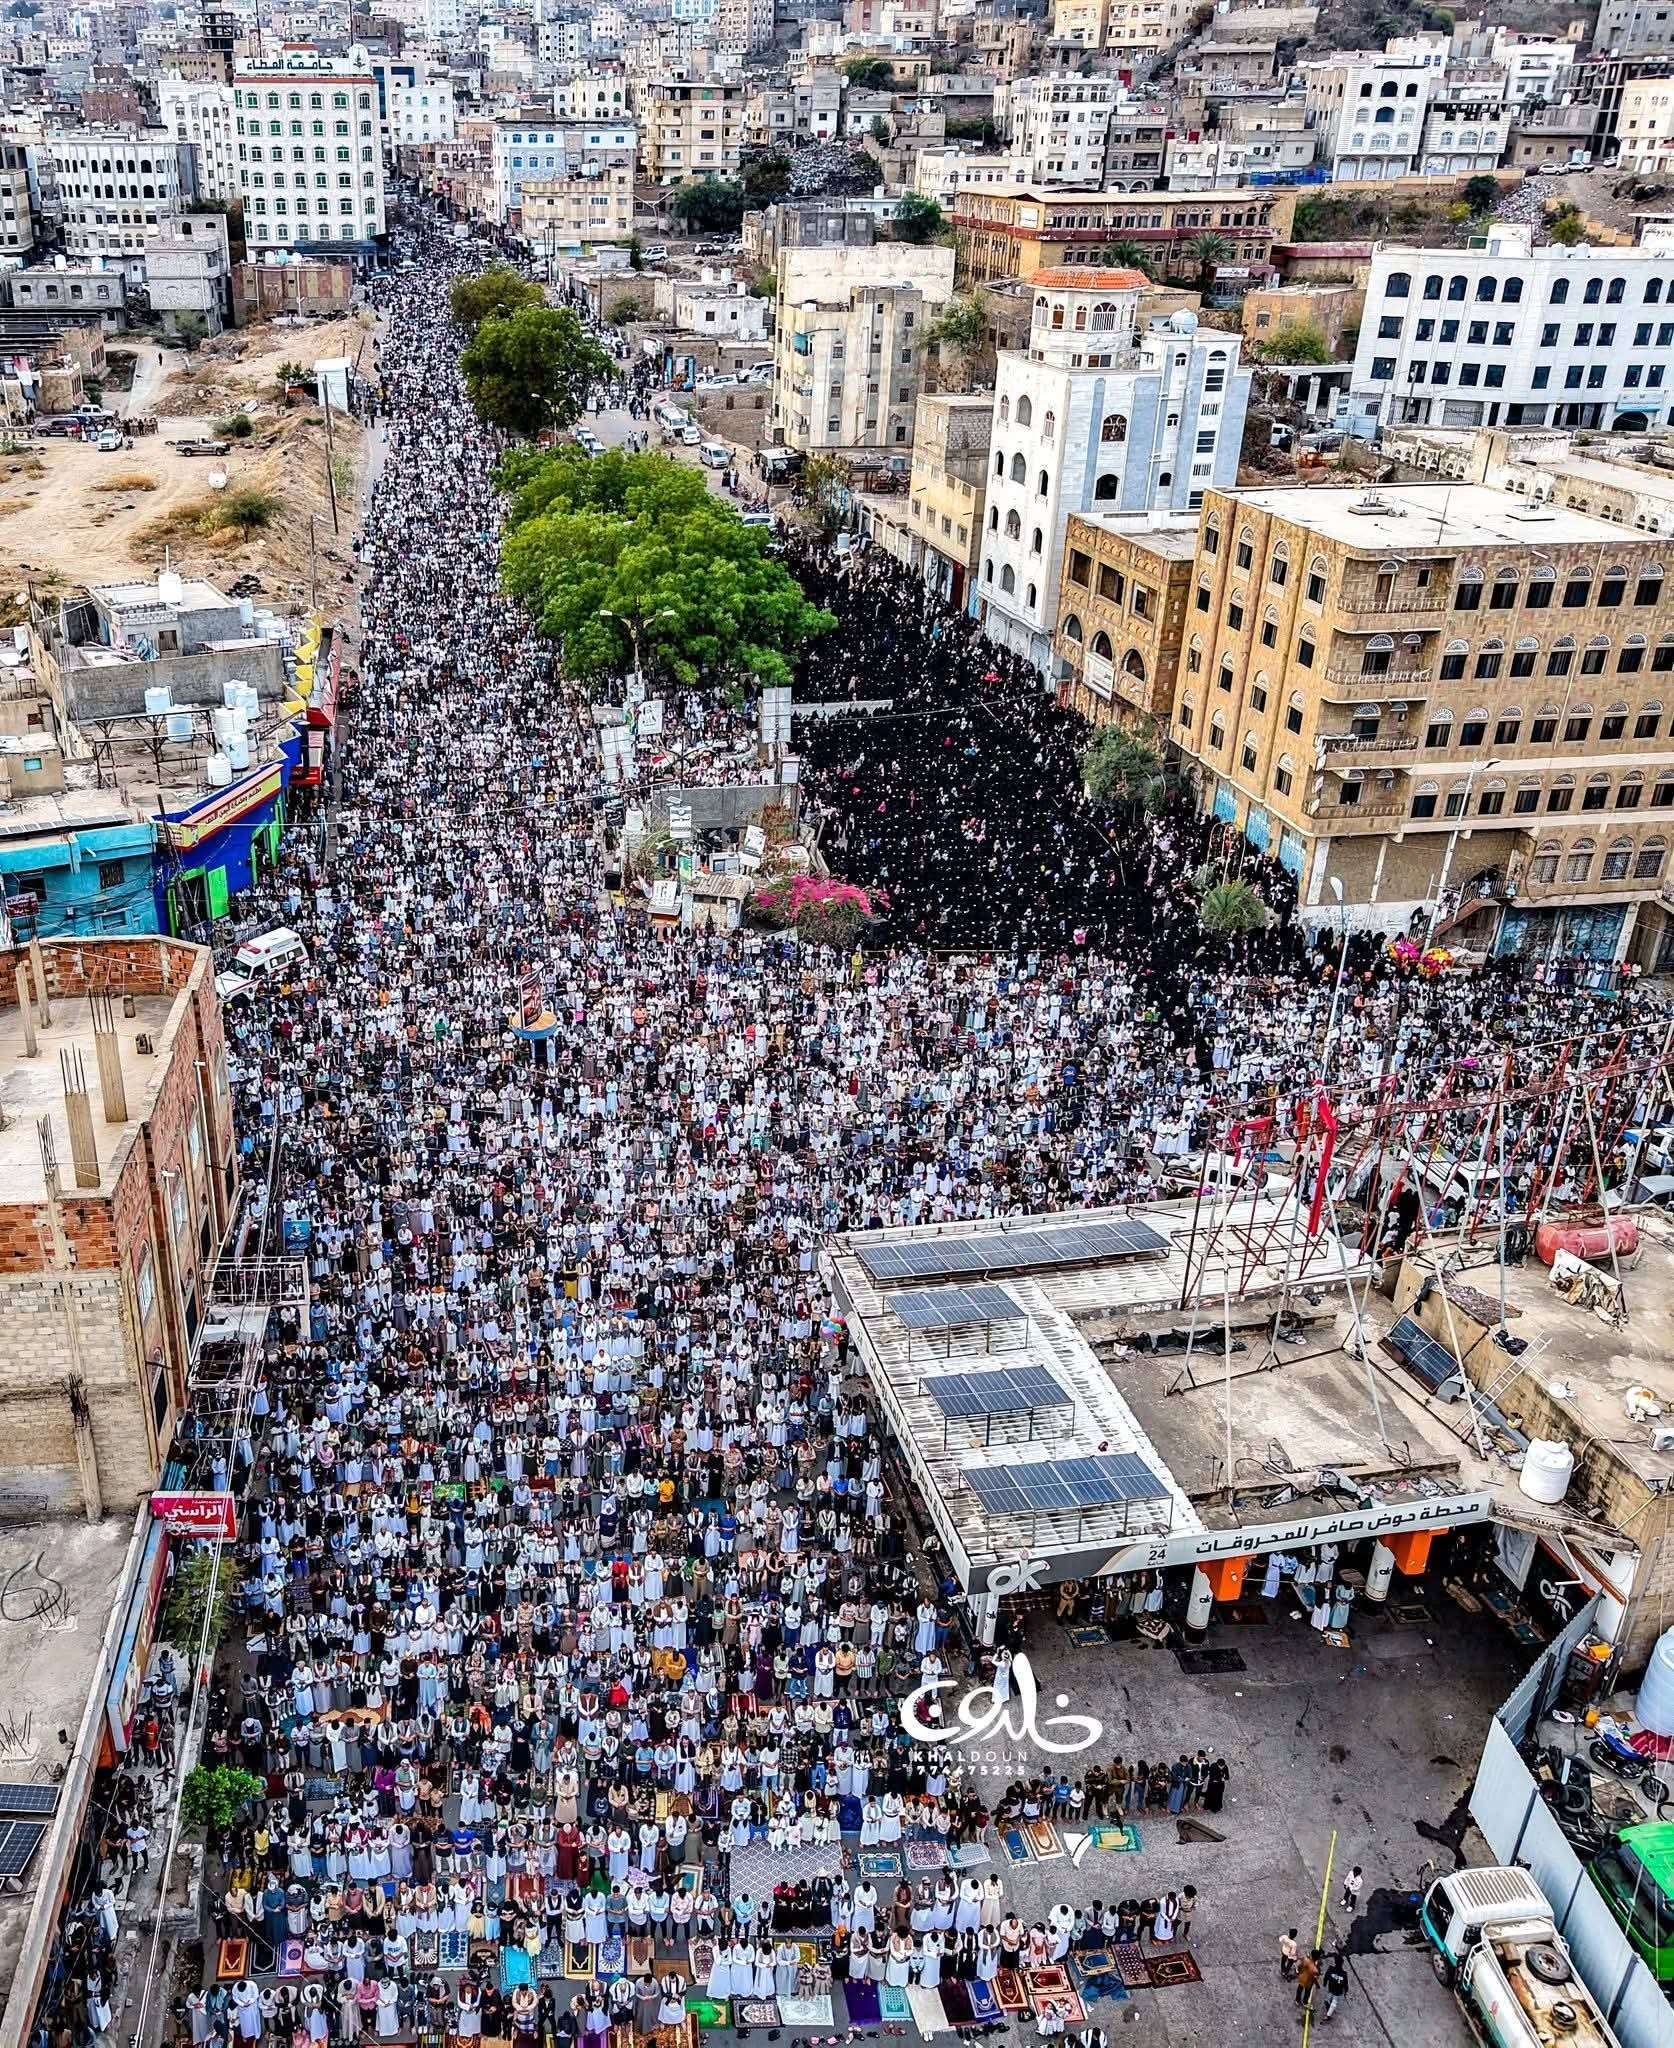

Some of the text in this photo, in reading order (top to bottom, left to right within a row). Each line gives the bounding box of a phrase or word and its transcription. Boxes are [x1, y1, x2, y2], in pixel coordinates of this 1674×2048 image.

[247, 58, 334, 72] جامعة العطاء
[1195, 1502, 1480, 1554] محطة حوض صافر للمحروقات
[1149, 1549, 1166, 1561] 24
